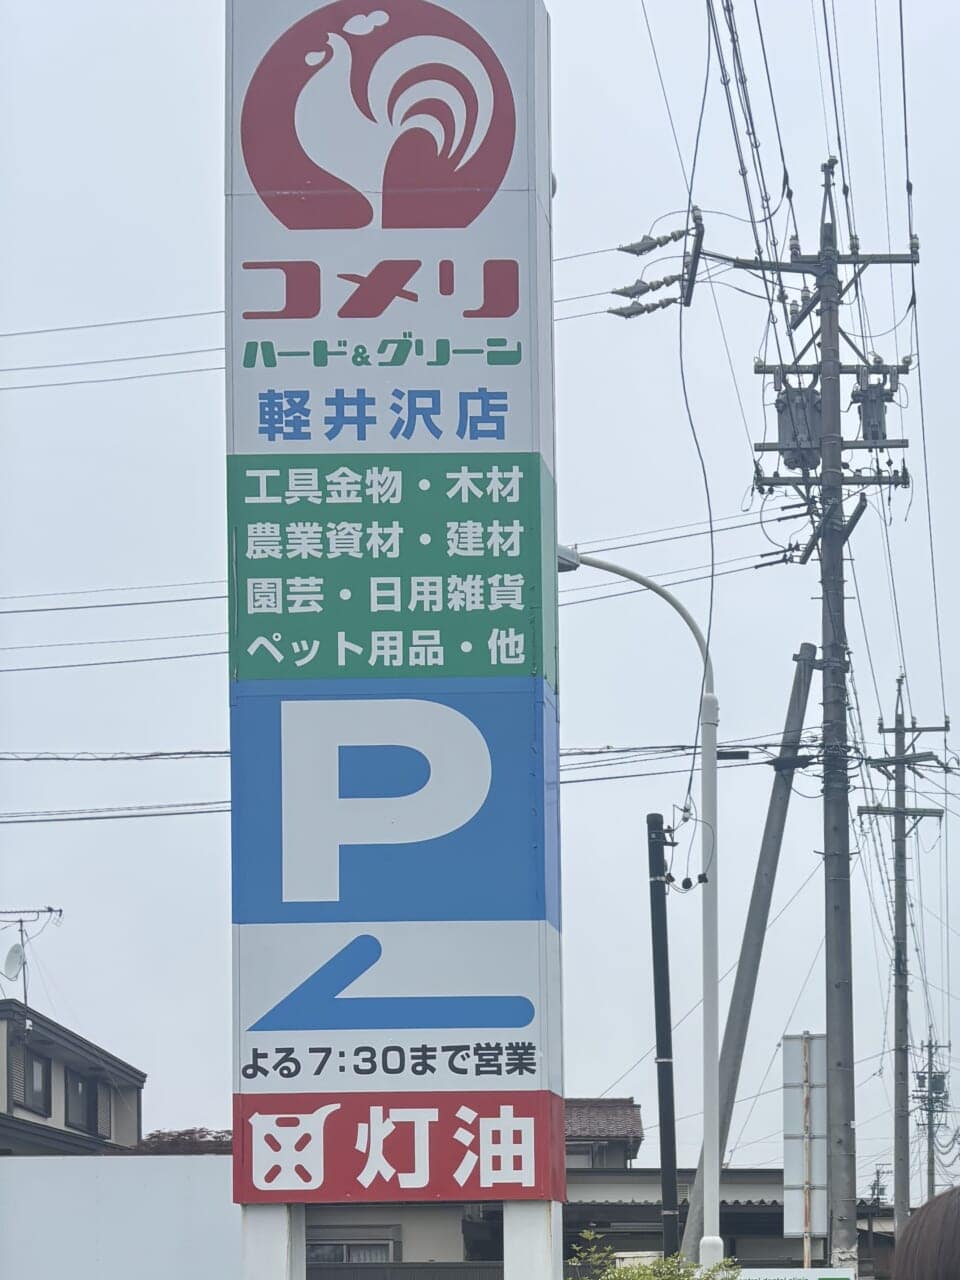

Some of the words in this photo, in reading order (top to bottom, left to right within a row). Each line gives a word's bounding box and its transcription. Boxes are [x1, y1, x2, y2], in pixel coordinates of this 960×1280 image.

[242, 259, 520, 320] コメリ
[242, 332, 522, 369] ハード&グリーン
[257, 387, 509, 442] 軽井沢店
[244, 465, 524, 505] 工具金物・木材
[245, 519, 524, 560] 農業資材・建材
[246, 573, 525, 615] 園芸・日用雑貨
[246, 627, 526, 667] ペット用品・他
[281, 698, 492, 903] P
[355, 1104, 536, 1189] 灯油
